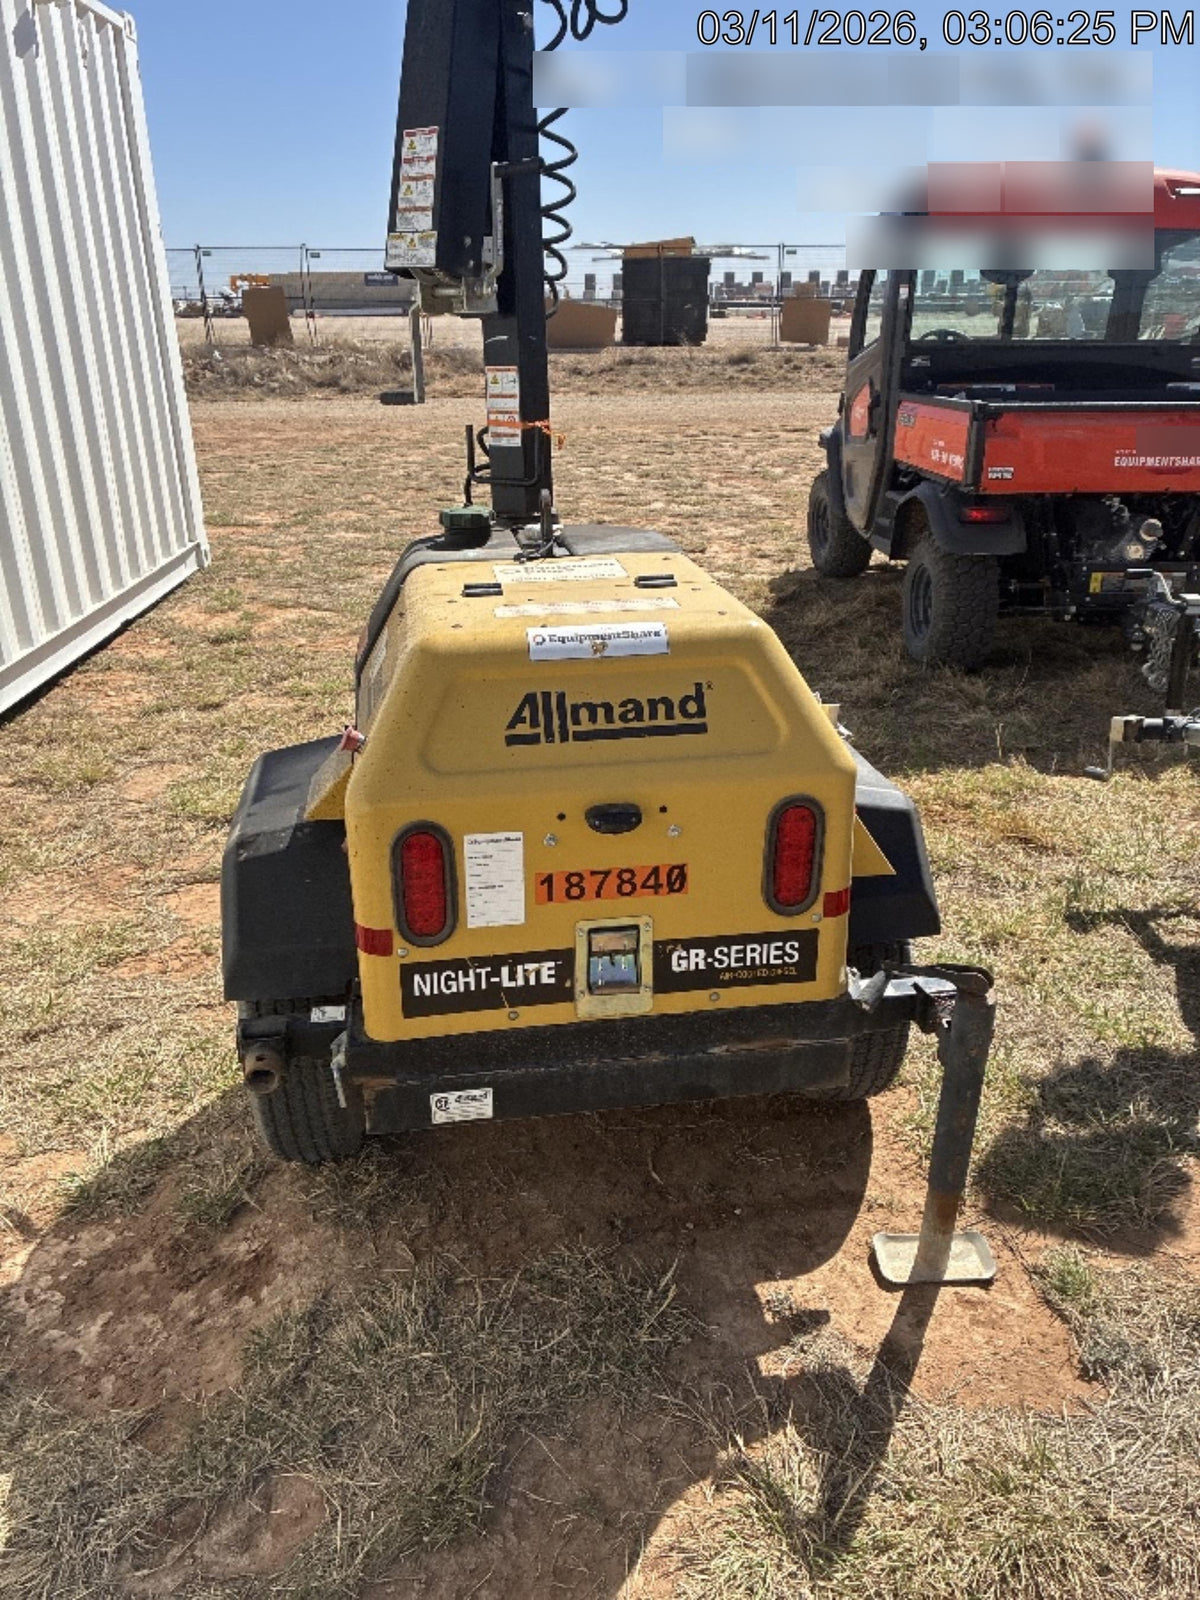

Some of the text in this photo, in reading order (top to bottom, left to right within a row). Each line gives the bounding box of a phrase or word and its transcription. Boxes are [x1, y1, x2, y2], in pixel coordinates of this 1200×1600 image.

[547, 629, 662, 645] EquipmentShare
[505, 682, 707, 744] Allmand
[540, 864, 687, 902] 187840
[671, 941, 800, 973] GR-SERIES
[413, 961, 556, 997] NIGHT-LITE
